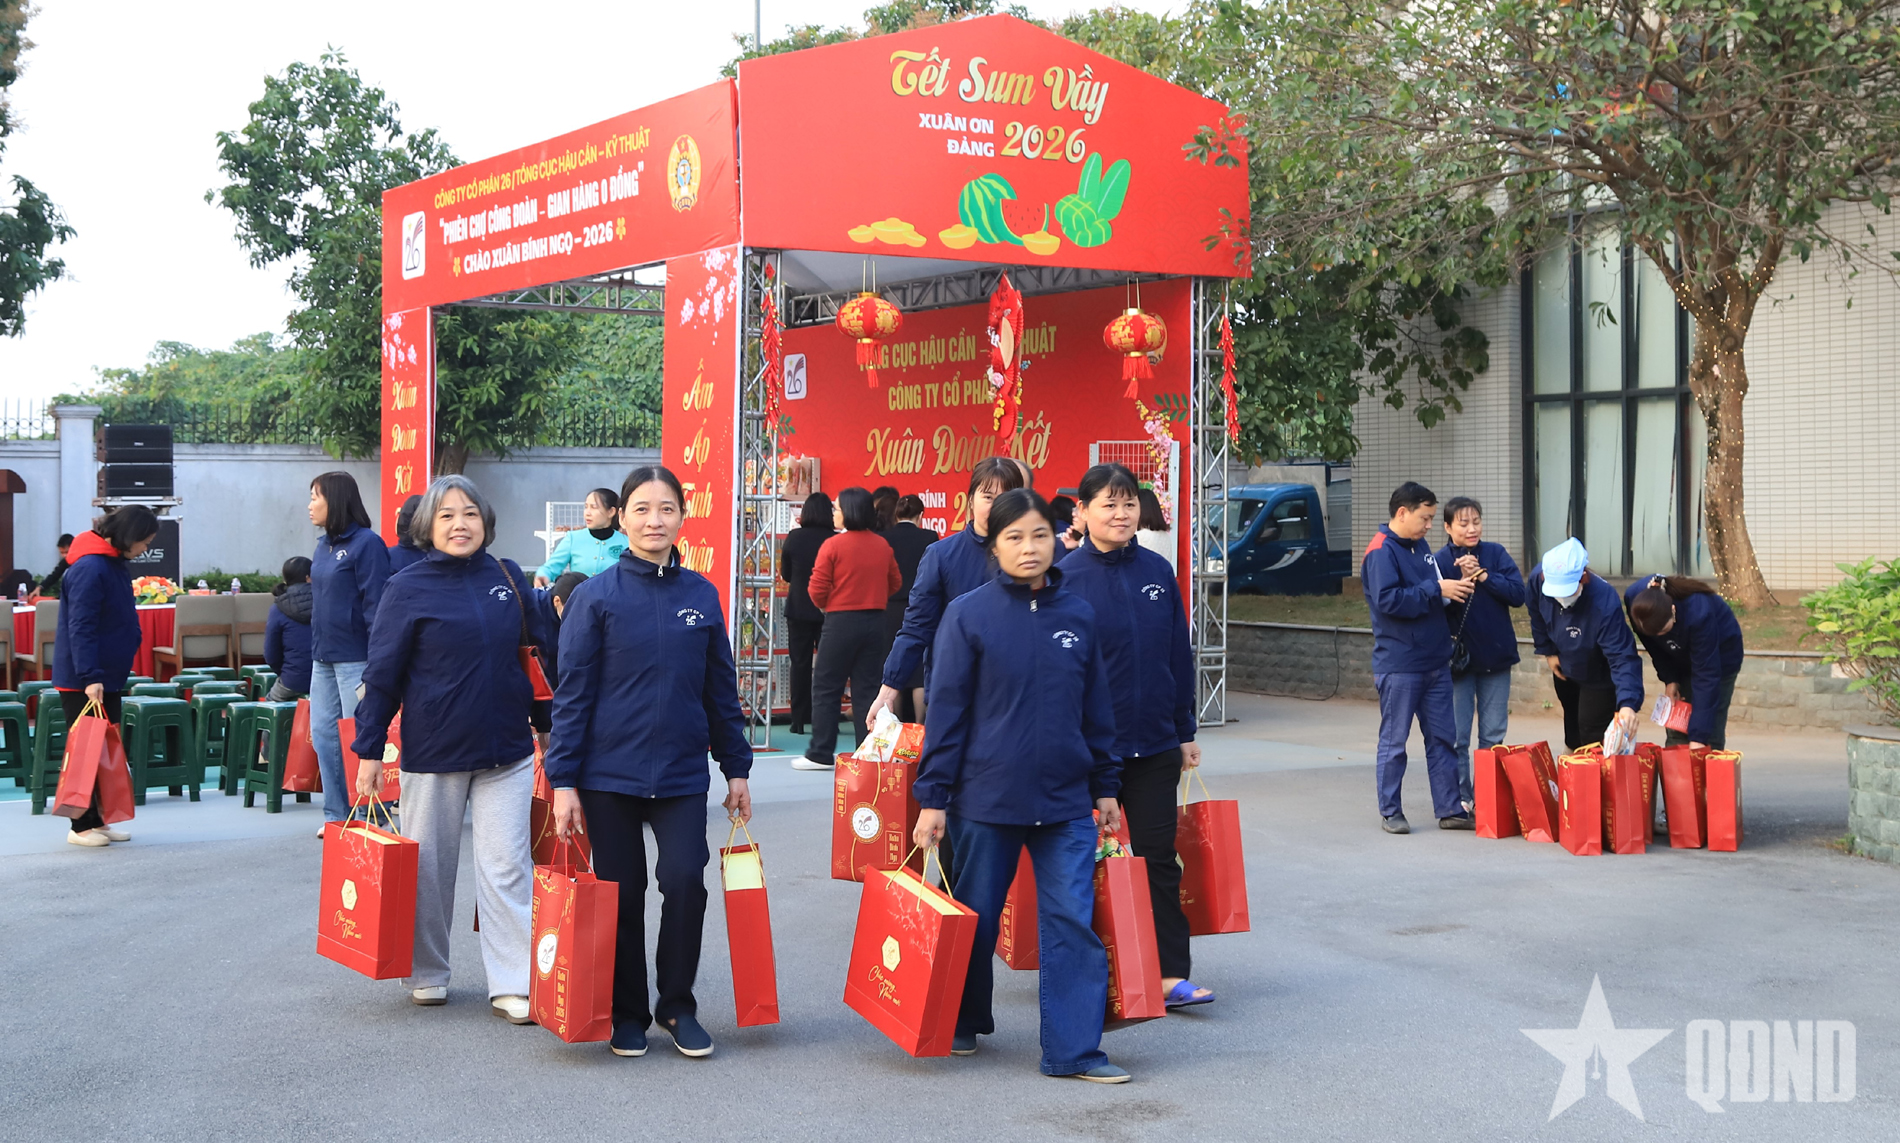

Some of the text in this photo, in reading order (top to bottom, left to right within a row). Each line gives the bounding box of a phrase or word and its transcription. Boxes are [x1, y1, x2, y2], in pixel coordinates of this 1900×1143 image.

[889, 46, 1109, 125] Tết Sum Vầy
[919, 112, 994, 135] XUÂN ƠN
[1001, 121, 1086, 163] 2026
[435, 188, 456, 209] CÔNG
[456, 185, 466, 202] TY
[466, 177, 478, 200] CỔ
[479, 172, 500, 196] PHẦN
[539, 158, 557, 181] CỤC
[558, 150, 577, 176] HẬU
[578, 142, 597, 167] CẦN
[606, 134, 618, 159] KỸ
[619, 125, 650, 153] THUẬT
[947, 136, 995, 157] ĐẢNG
[469, 209, 487, 241] CHỢ
[488, 204, 512, 234] CÔNG
[513, 195, 538, 228] ĐOÀN
[547, 189, 570, 219] GIAN
[572, 180, 599, 212] HÀNG
[464, 248, 491, 274] CHÀO
[492, 241, 520, 268] XUÂN
[522, 236, 548, 262] BÍNH
[549, 231, 573, 255] NGỌ
[583, 221, 613, 247] 2026
[892, 342, 917, 372] CỤC
[920, 335, 945, 370] HẬU
[949, 327, 976, 362] CẦN
[1020, 321, 1057, 359] HUẬT
[391, 380, 418, 411] Xuân
[682, 358, 714, 411] Ấm
[888, 381, 921, 411] CÔNG
[925, 383, 939, 408] TY
[942, 371, 960, 407] CỔ
[391, 423, 417, 453] Đoàn
[684, 418, 710, 472] Áp
[864, 427, 926, 477] Xuân
[1010, 410, 1052, 470] Kết
[395, 460, 413, 495] Kết
[922, 517, 947, 537] NGỌ
[677, 536, 714, 573] Quân
